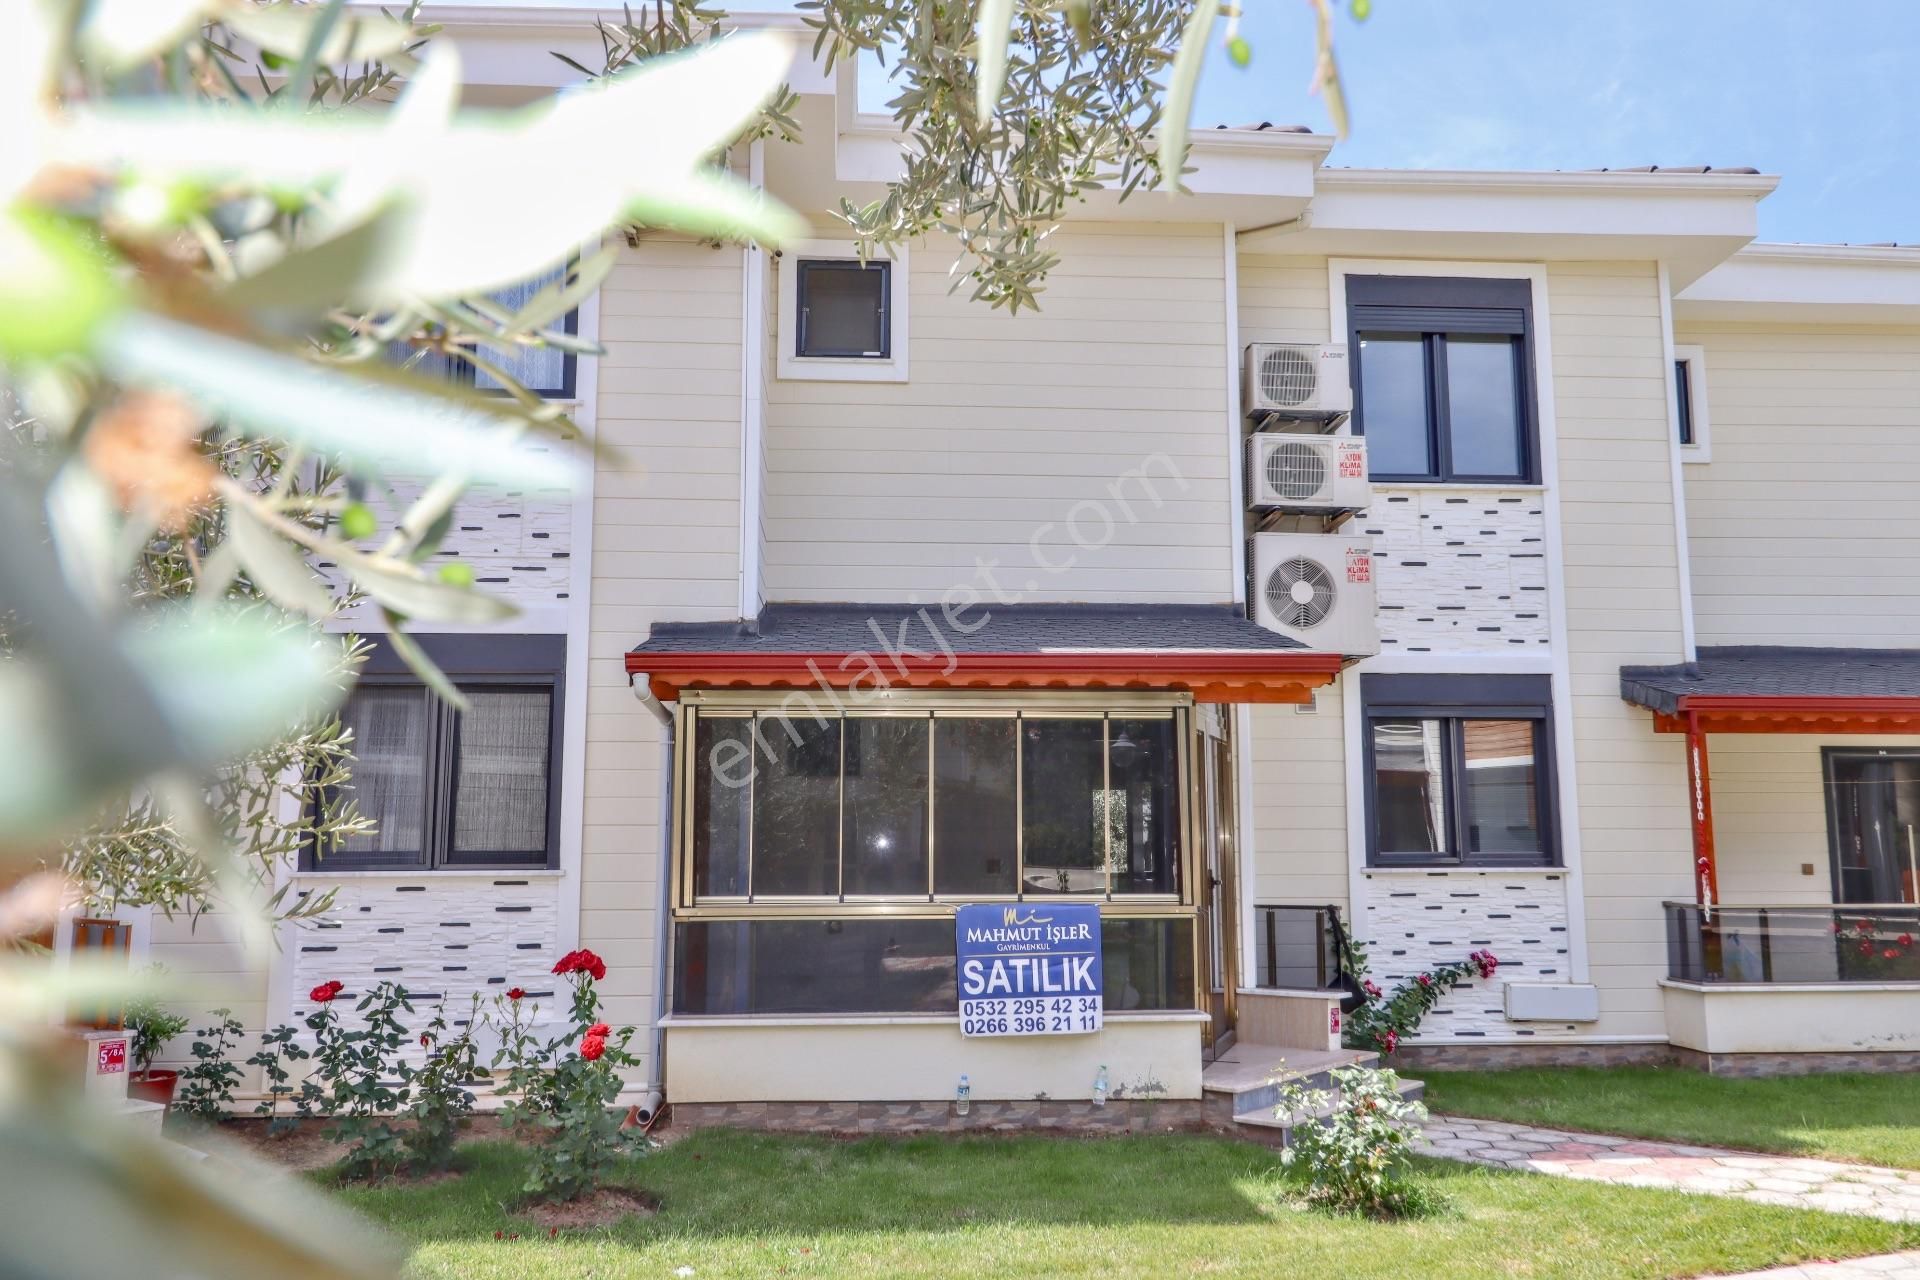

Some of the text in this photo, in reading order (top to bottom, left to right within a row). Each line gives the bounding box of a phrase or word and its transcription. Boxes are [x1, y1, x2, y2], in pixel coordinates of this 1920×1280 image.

[966, 923, 1092, 944] MAHMUT İŞLER
[996, 942, 1051, 951] GAYRİMENKUL
[963, 956, 1097, 995] SATILIK
[963, 997, 1098, 1017] 0532 295 42 34
[964, 1015, 1096, 1034] 0266 396 21 11
